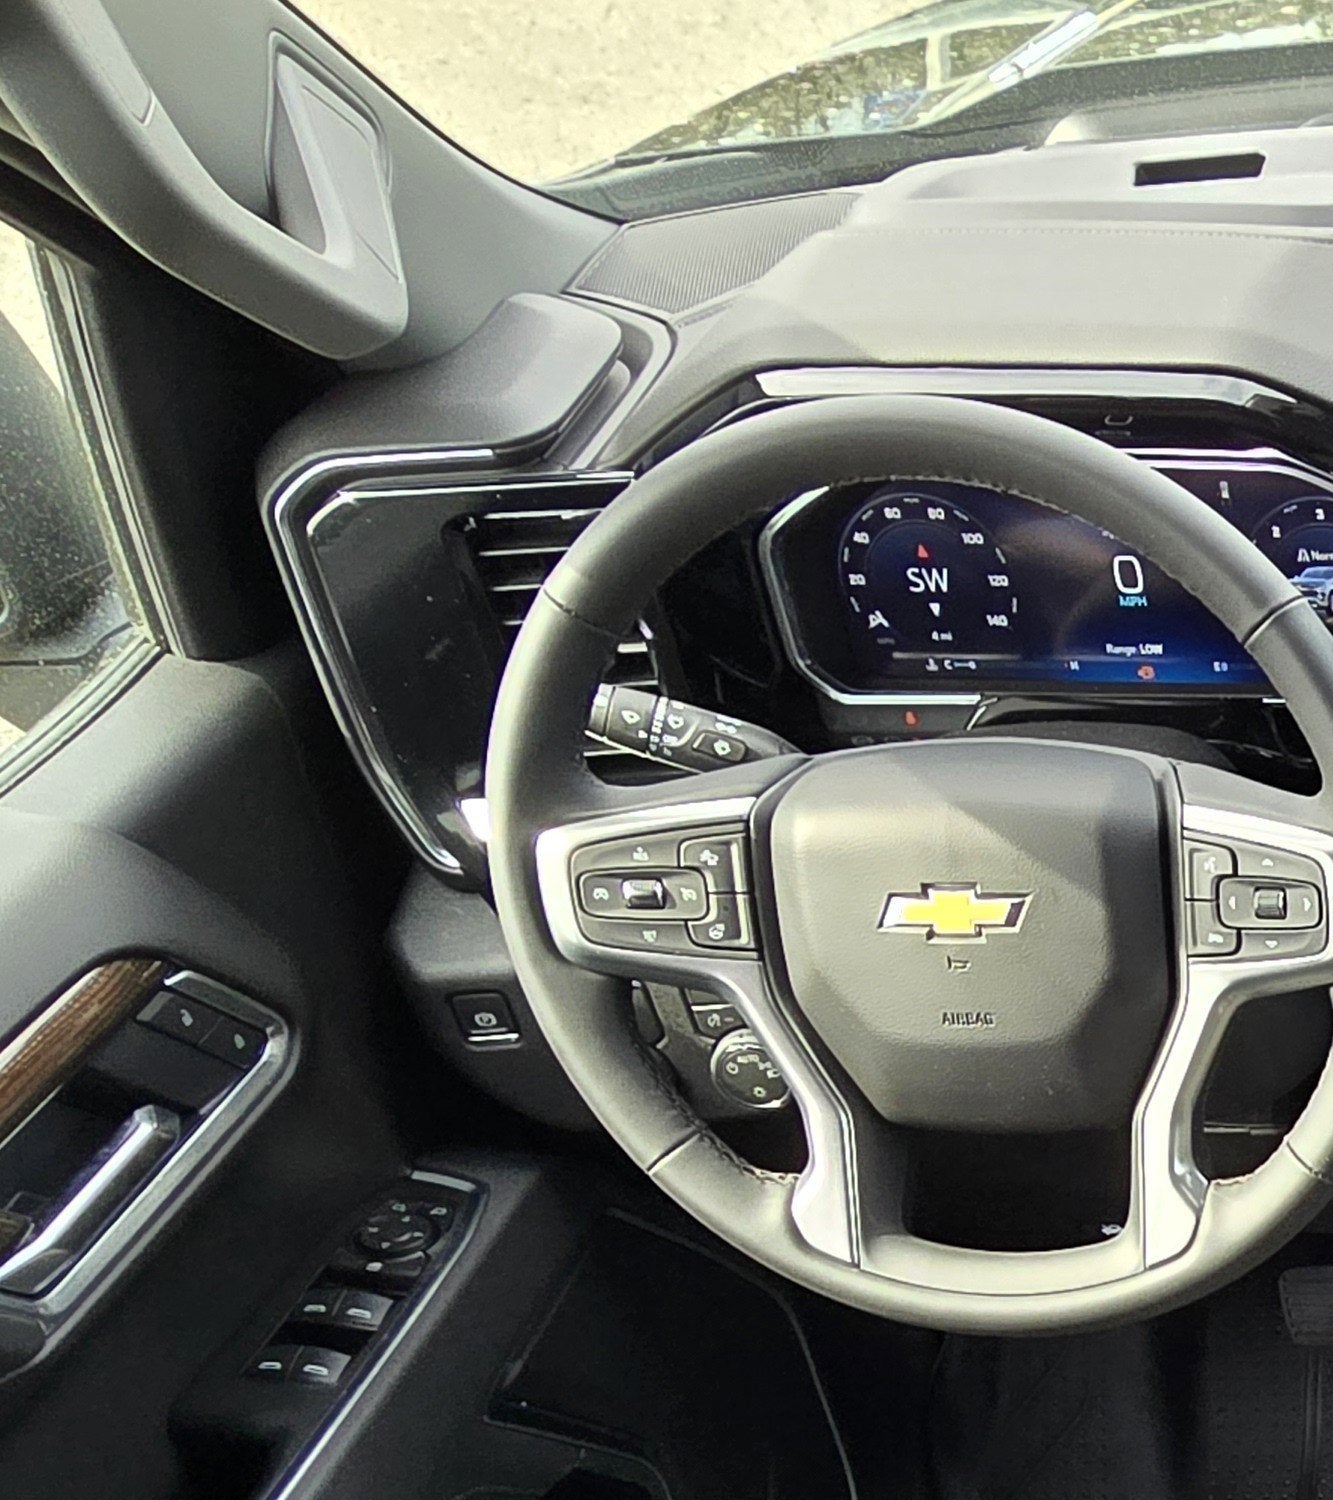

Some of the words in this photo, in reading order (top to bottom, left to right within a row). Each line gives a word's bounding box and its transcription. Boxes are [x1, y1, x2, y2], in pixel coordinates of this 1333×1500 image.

[1315, 508, 1326, 521] 3
[853, 531, 870, 544] 40
[1271, 525, 1282, 538] 2
[961, 532, 984, 545] 100
[906, 567, 949, 593] SW
[987, 575, 1009, 587] 120
[1112, 555, 1144, 594] 0
[1118, 595, 1148, 607] MPH
[986, 614, 1008, 627] 140
[1106, 643, 1137, 657] Range
[1138, 643, 1163, 655] LOW
[941, 1011, 994, 1026] AIRBAG
